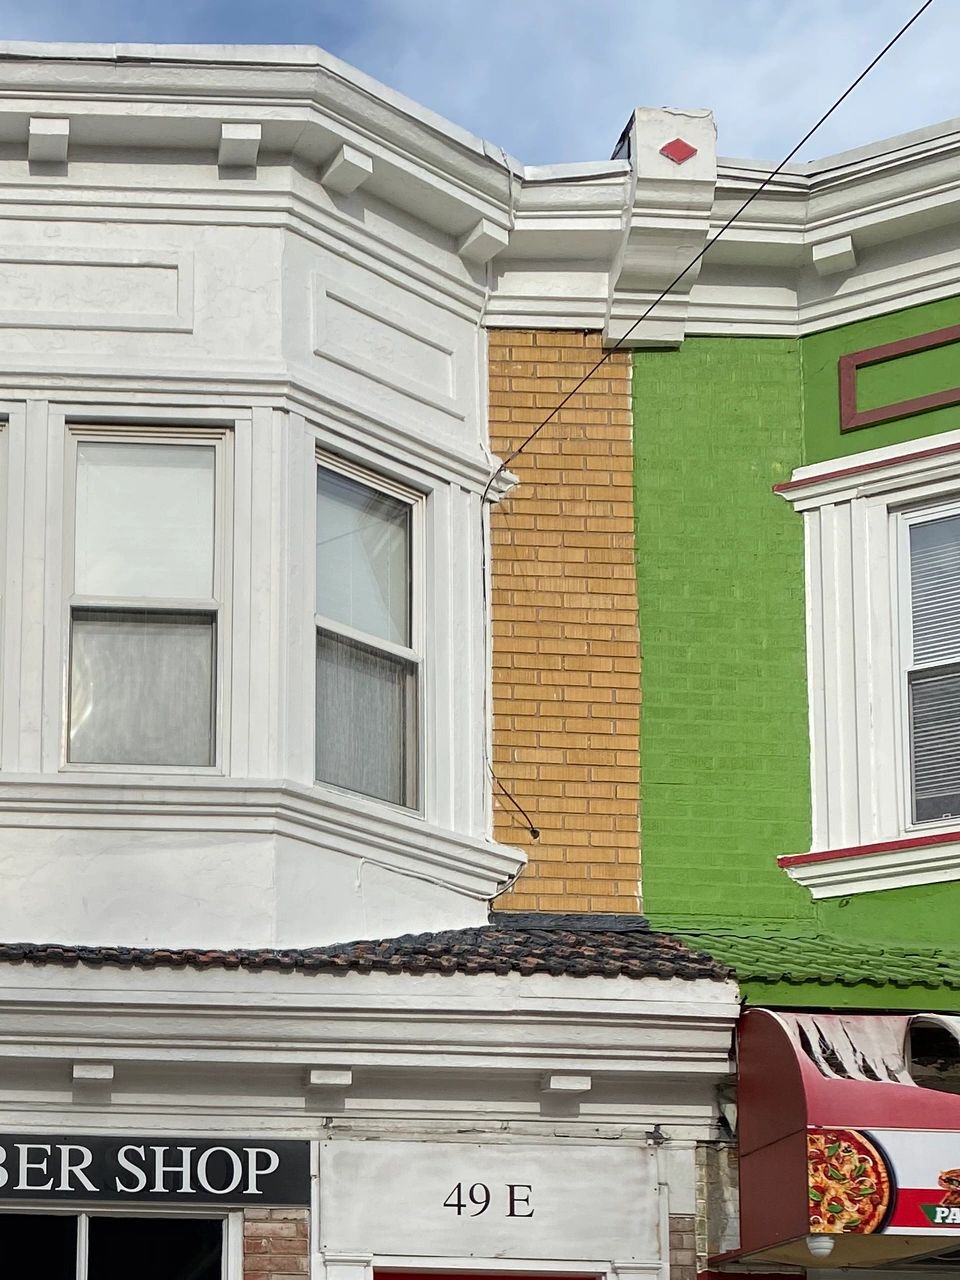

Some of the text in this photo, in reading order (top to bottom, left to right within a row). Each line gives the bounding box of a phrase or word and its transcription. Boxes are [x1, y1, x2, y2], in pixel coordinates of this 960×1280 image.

[115, 1144, 281, 1195] SHOP
[443, 1182, 535, 1218] 49 E
